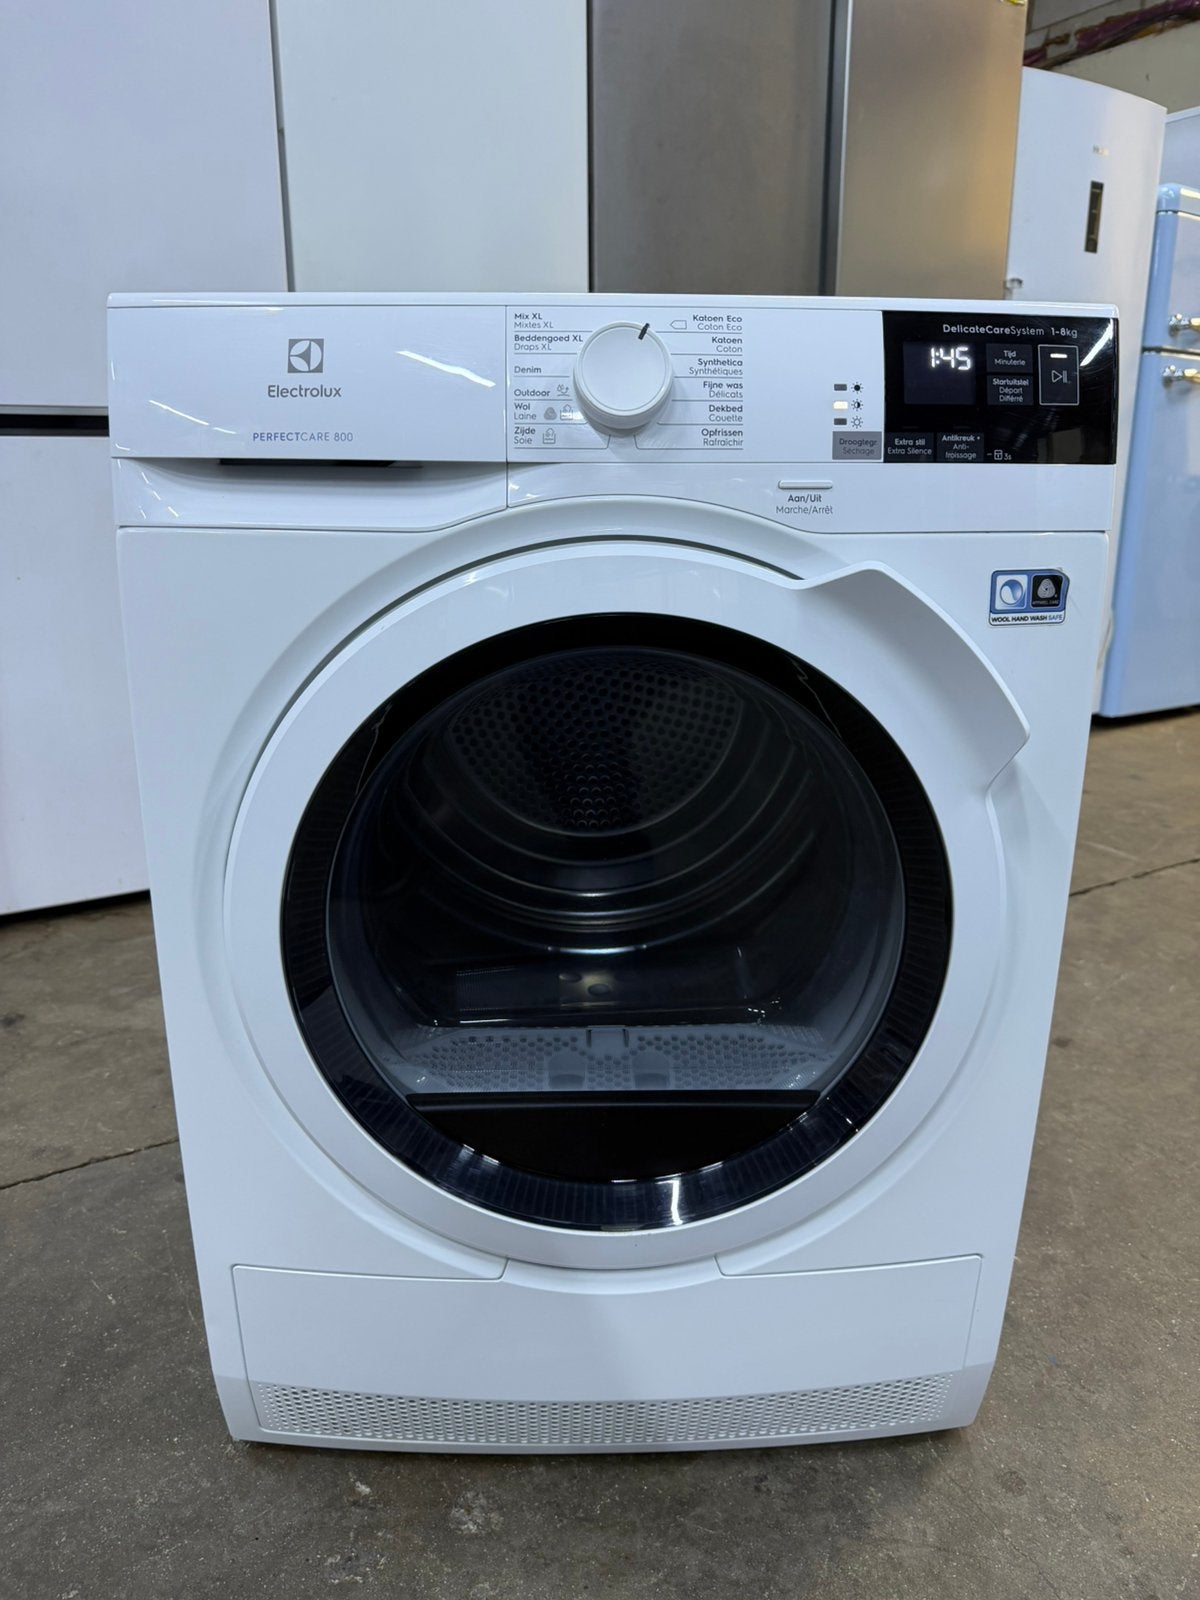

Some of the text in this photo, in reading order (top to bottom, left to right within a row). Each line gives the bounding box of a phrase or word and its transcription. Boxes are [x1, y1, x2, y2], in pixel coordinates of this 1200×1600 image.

[514, 321, 553, 329] Mixtes XL
[697, 323, 723, 331] Coton
[943, 324, 1077, 338] DelicateCareSystem 1-8kg
[514, 334, 583, 343] Beddengoed XL
[712, 336, 742, 344] Katoen
[514, 343, 551, 351] Draps XL
[716, 345, 742, 353] Coton
[1003, 350, 1016, 358] Tijd
[698, 358, 743, 367] Synthetica
[929, 347, 972, 371] 1:45
[995, 358, 1026, 366] Minuterie
[514, 366, 541, 374] Denim
[689, 367, 743, 376] Synthétiques
[703, 381, 724, 390] Fijne
[993, 378, 1029, 386] Startuitstel
[268, 384, 342, 398] Electrolux
[514, 389, 550, 397] Outdoor
[709, 390, 743, 398] Délicats
[999, 386, 1023, 395] Départ
[514, 403, 530, 411] Wol
[709, 405, 743, 413] Dekbed
[514, 412, 536, 420] Laine
[709, 414, 743, 422] Couette
[514, 427, 535, 436] Zijde
[701, 428, 743, 438] Opfrissen
[253, 432, 353, 441] PERFECTCARE 800
[942, 434, 975, 442] Antikreuk
[894, 438, 926, 446] Extra stil
[888, 447, 932, 456] Extra Silence
[1004, 453, 1012, 461] 3s
[787, 494, 822, 503] Aan/Uit
[776, 505, 833, 515] Marche/Arrêt
